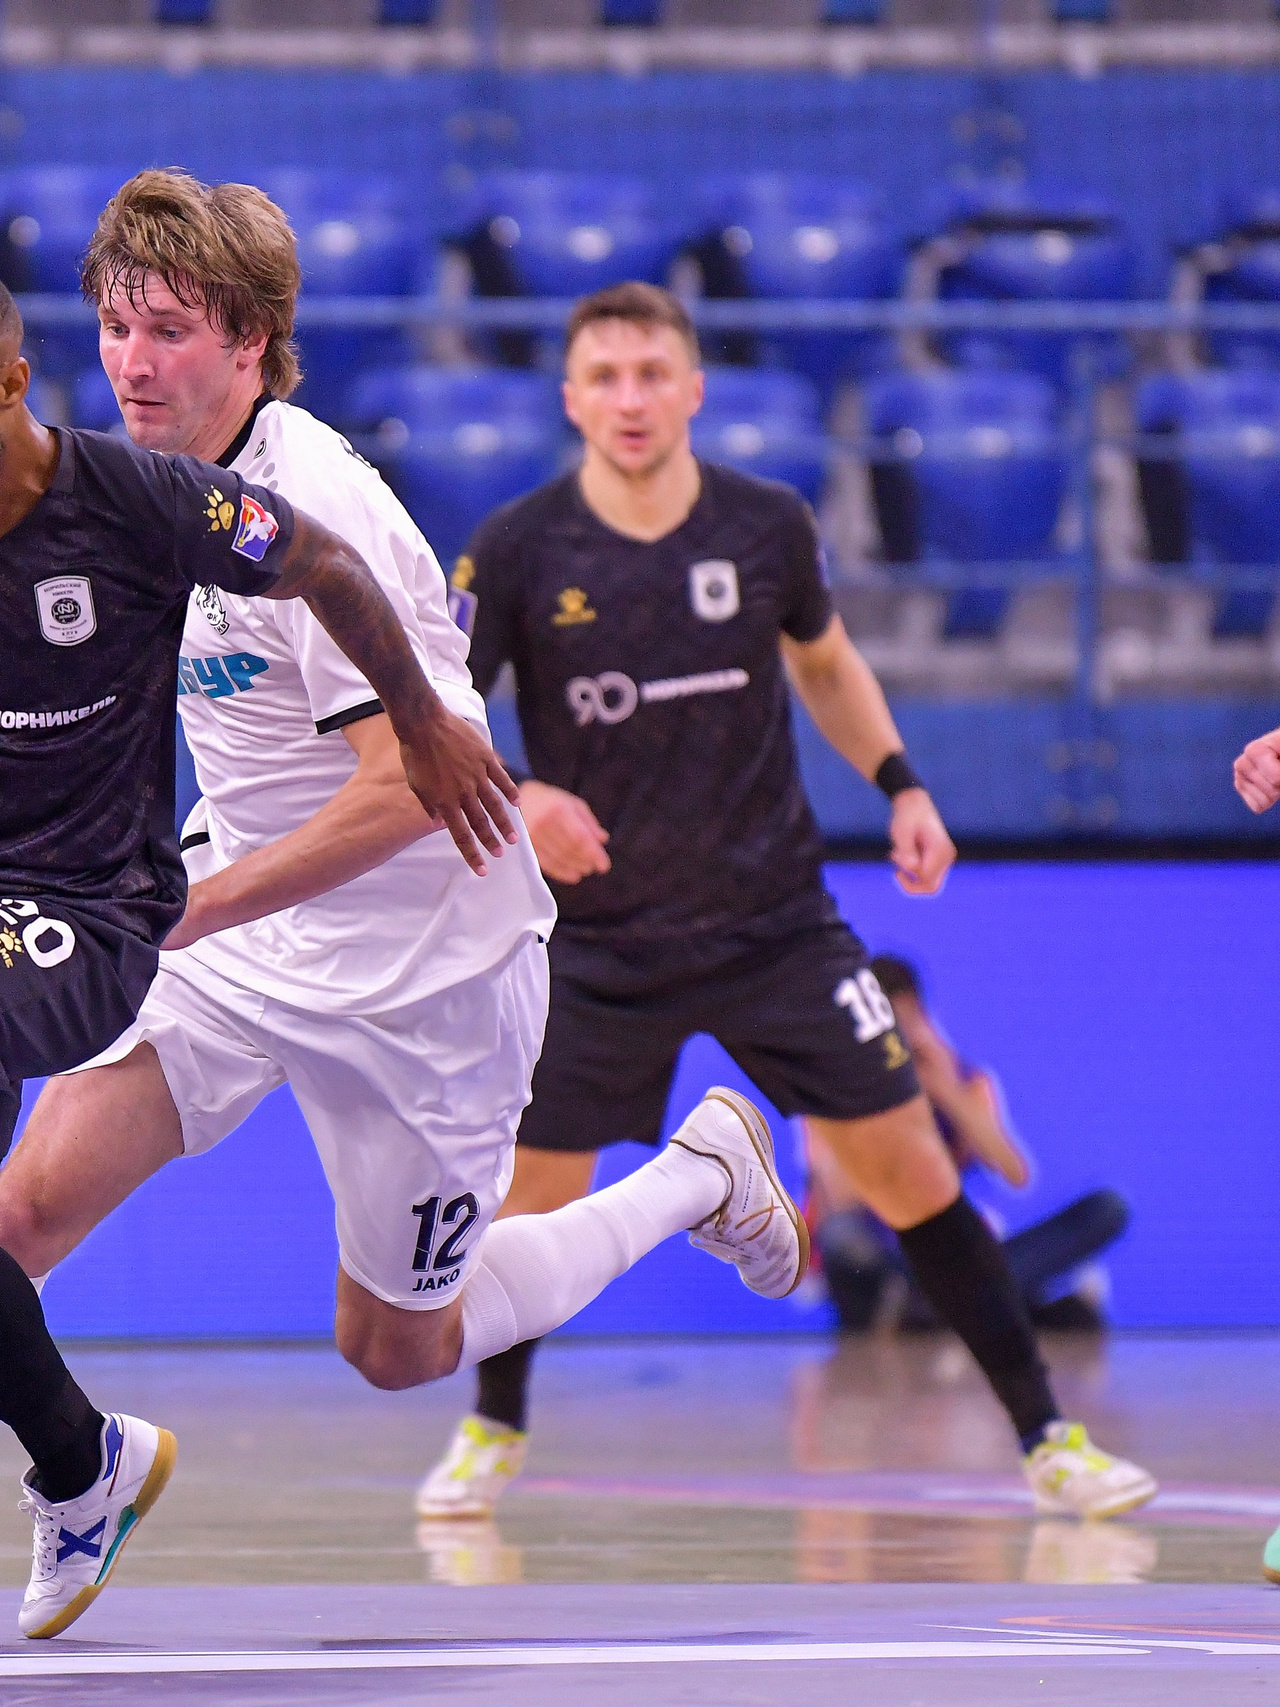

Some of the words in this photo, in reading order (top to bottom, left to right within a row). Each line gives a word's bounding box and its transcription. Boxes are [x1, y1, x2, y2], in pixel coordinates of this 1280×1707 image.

[177, 652, 270, 699] БУР
[411, 1191, 481, 1272] 12
[412, 1268, 461, 1292] JAKO
